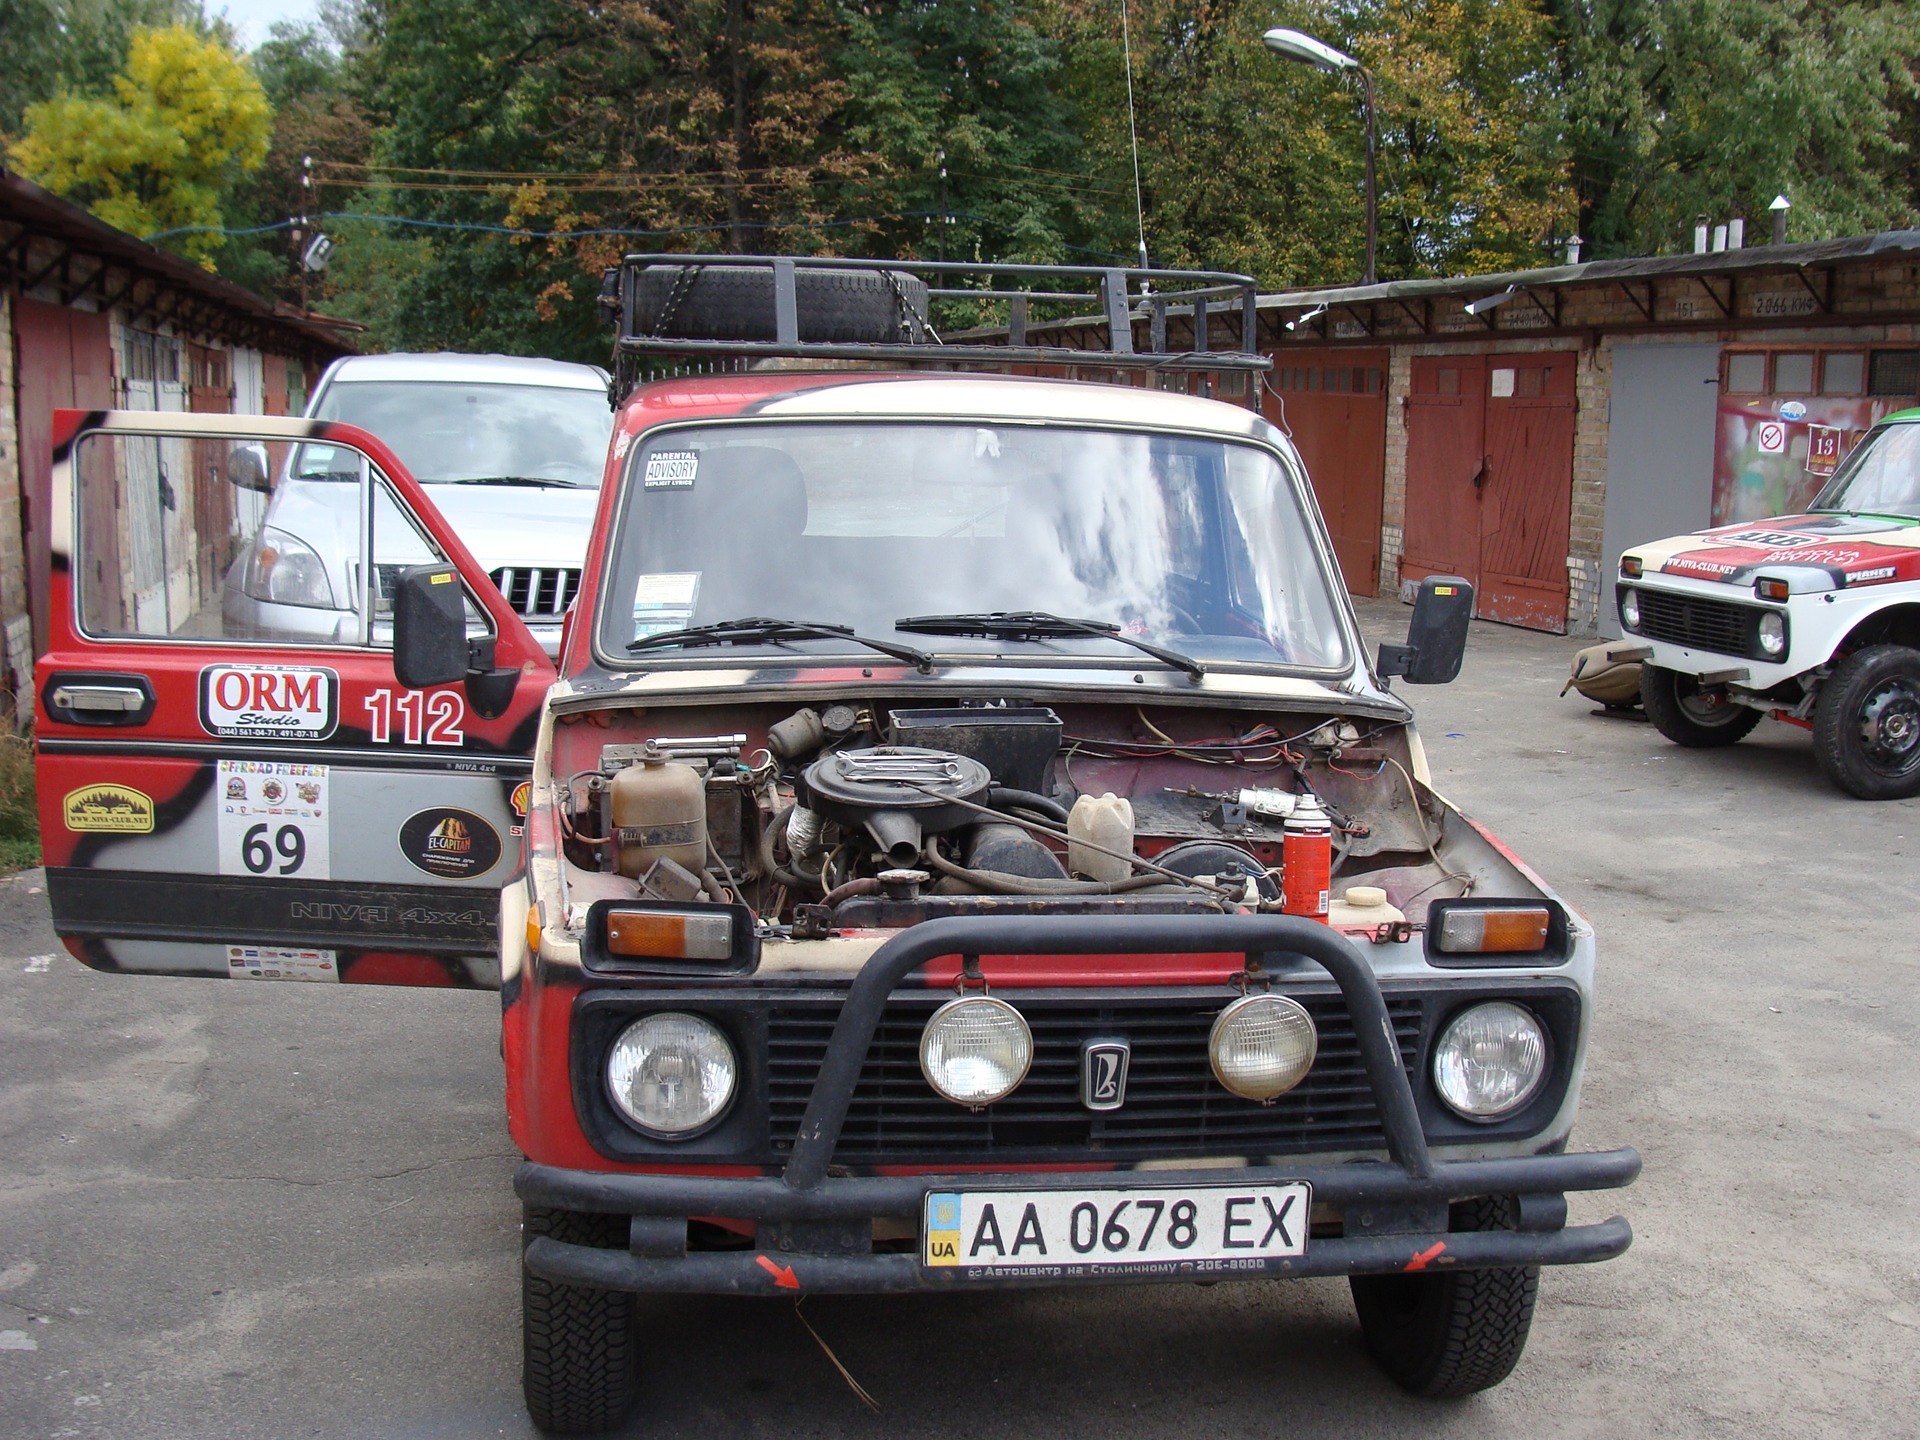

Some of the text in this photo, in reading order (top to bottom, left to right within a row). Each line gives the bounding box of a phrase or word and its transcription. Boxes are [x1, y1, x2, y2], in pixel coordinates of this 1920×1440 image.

[1816, 437, 1834, 456] 13
[650, 452, 697, 460] PARENTAL
[647, 461, 696, 479] ADVISORY
[1721, 532, 1812, 546] ARB
[215, 671, 322, 713] ORM
[235, 713, 301, 726] Studio
[365, 688, 464, 746] 112
[218, 727, 319, 738] (044) 561-04-71, 491-07-18
[220, 761, 326, 777] OFFROAD FREEFEST
[454, 763, 477, 771] NIVA
[70, 815, 148, 824] WWW.NIVA-CLUB.NET
[242, 823, 306, 874] 69
[428, 836, 471, 851] EL-CAPITAN
[291, 902, 485, 925] NIVA 4x4
[969, 1195, 1297, 1258] AA 0678 EX
[931, 1241, 956, 1258] UA
[984, 1265, 1062, 1279] Автоцентр
[1067, 1266, 1084, 1276] на
[1090, 1262, 1176, 1275] Столичному
